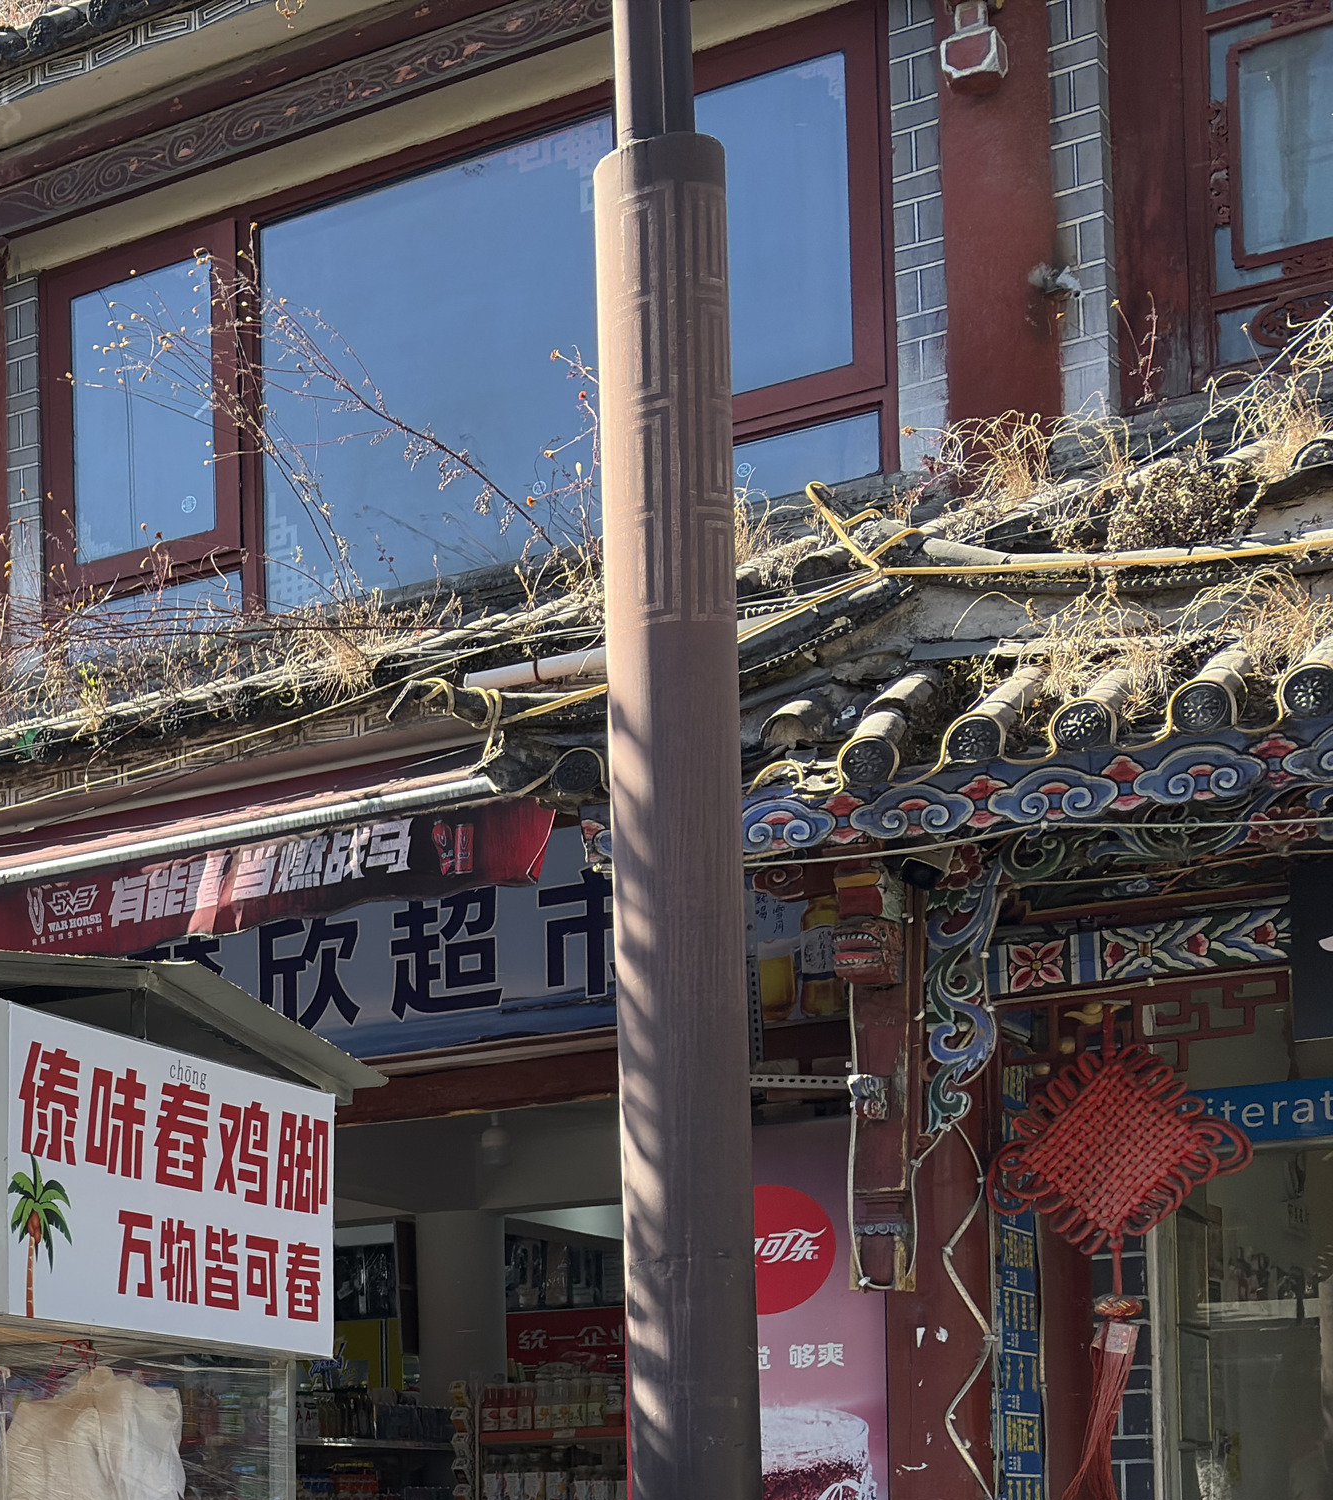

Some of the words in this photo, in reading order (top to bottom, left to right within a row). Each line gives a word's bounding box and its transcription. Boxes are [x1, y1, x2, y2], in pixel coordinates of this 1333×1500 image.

[109, 856, 230, 926] 有能量
[232, 819, 414, 899] 当燃战马
[47, 918, 68, 931] WAR
[70, 912, 102, 929] HORSE
[169, 1060, 207, 1089] chōng
[1182, 1090, 1333, 1127] iterat
[18, 1041, 330, 1216] 傣味舂鸡脚
[117, 1210, 321, 1322] 万物皆可舂
[789, 1342, 845, 1369] 够爽
